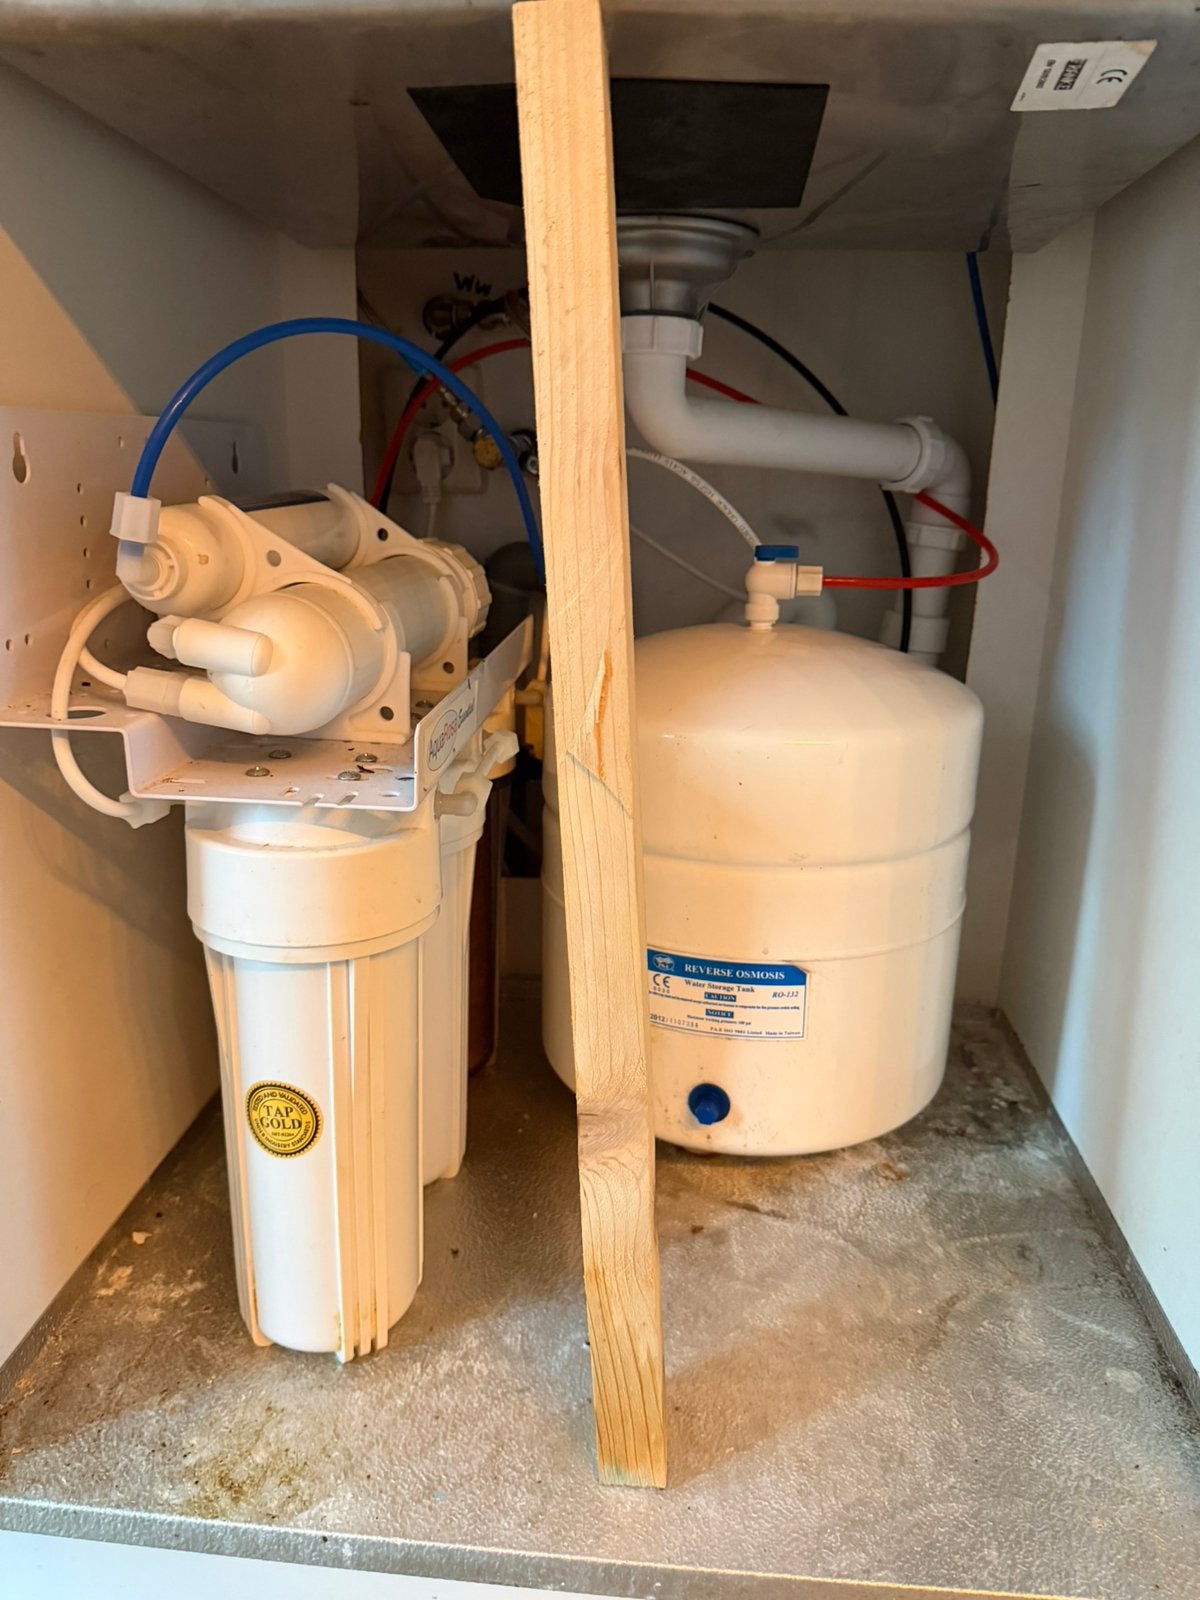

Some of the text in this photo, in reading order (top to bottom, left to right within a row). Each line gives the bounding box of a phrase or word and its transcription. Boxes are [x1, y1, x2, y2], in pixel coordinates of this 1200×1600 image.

[684, 963, 785, 980] REVERSE OSMOSIS
[684, 979, 755, 993] Water Storage Tank
[704, 993, 736, 1002] CAUTION
[772, 990, 799, 999] RO-132
[706, 1009, 732, 1018] NOTICE
[263, 1091, 278, 1099] AND
[278, 1092, 308, 1115] VALIDATED
[263, 1105, 293, 1118] TAP
[260, 1116, 302, 1130] GOLD
